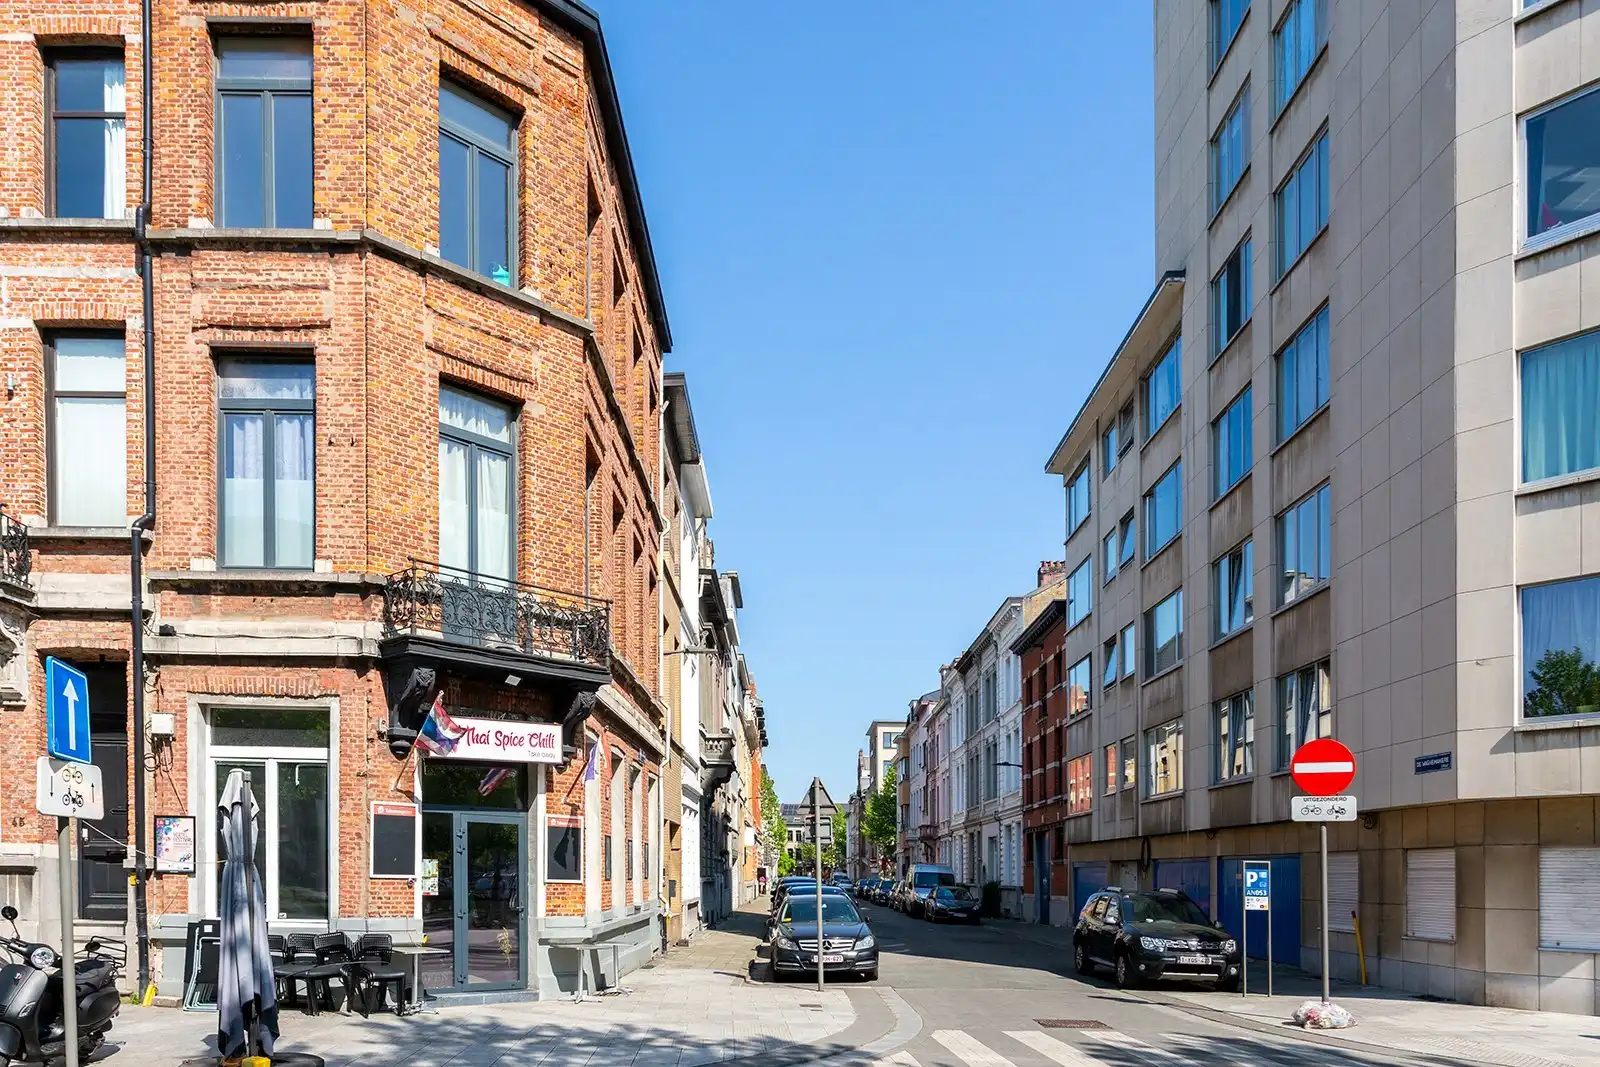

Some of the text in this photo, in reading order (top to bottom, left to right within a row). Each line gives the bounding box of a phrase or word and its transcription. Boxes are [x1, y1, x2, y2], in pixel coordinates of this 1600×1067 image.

[465, 726, 555, 751] Thai Spice Chili
[1246, 872, 1258, 887] P
